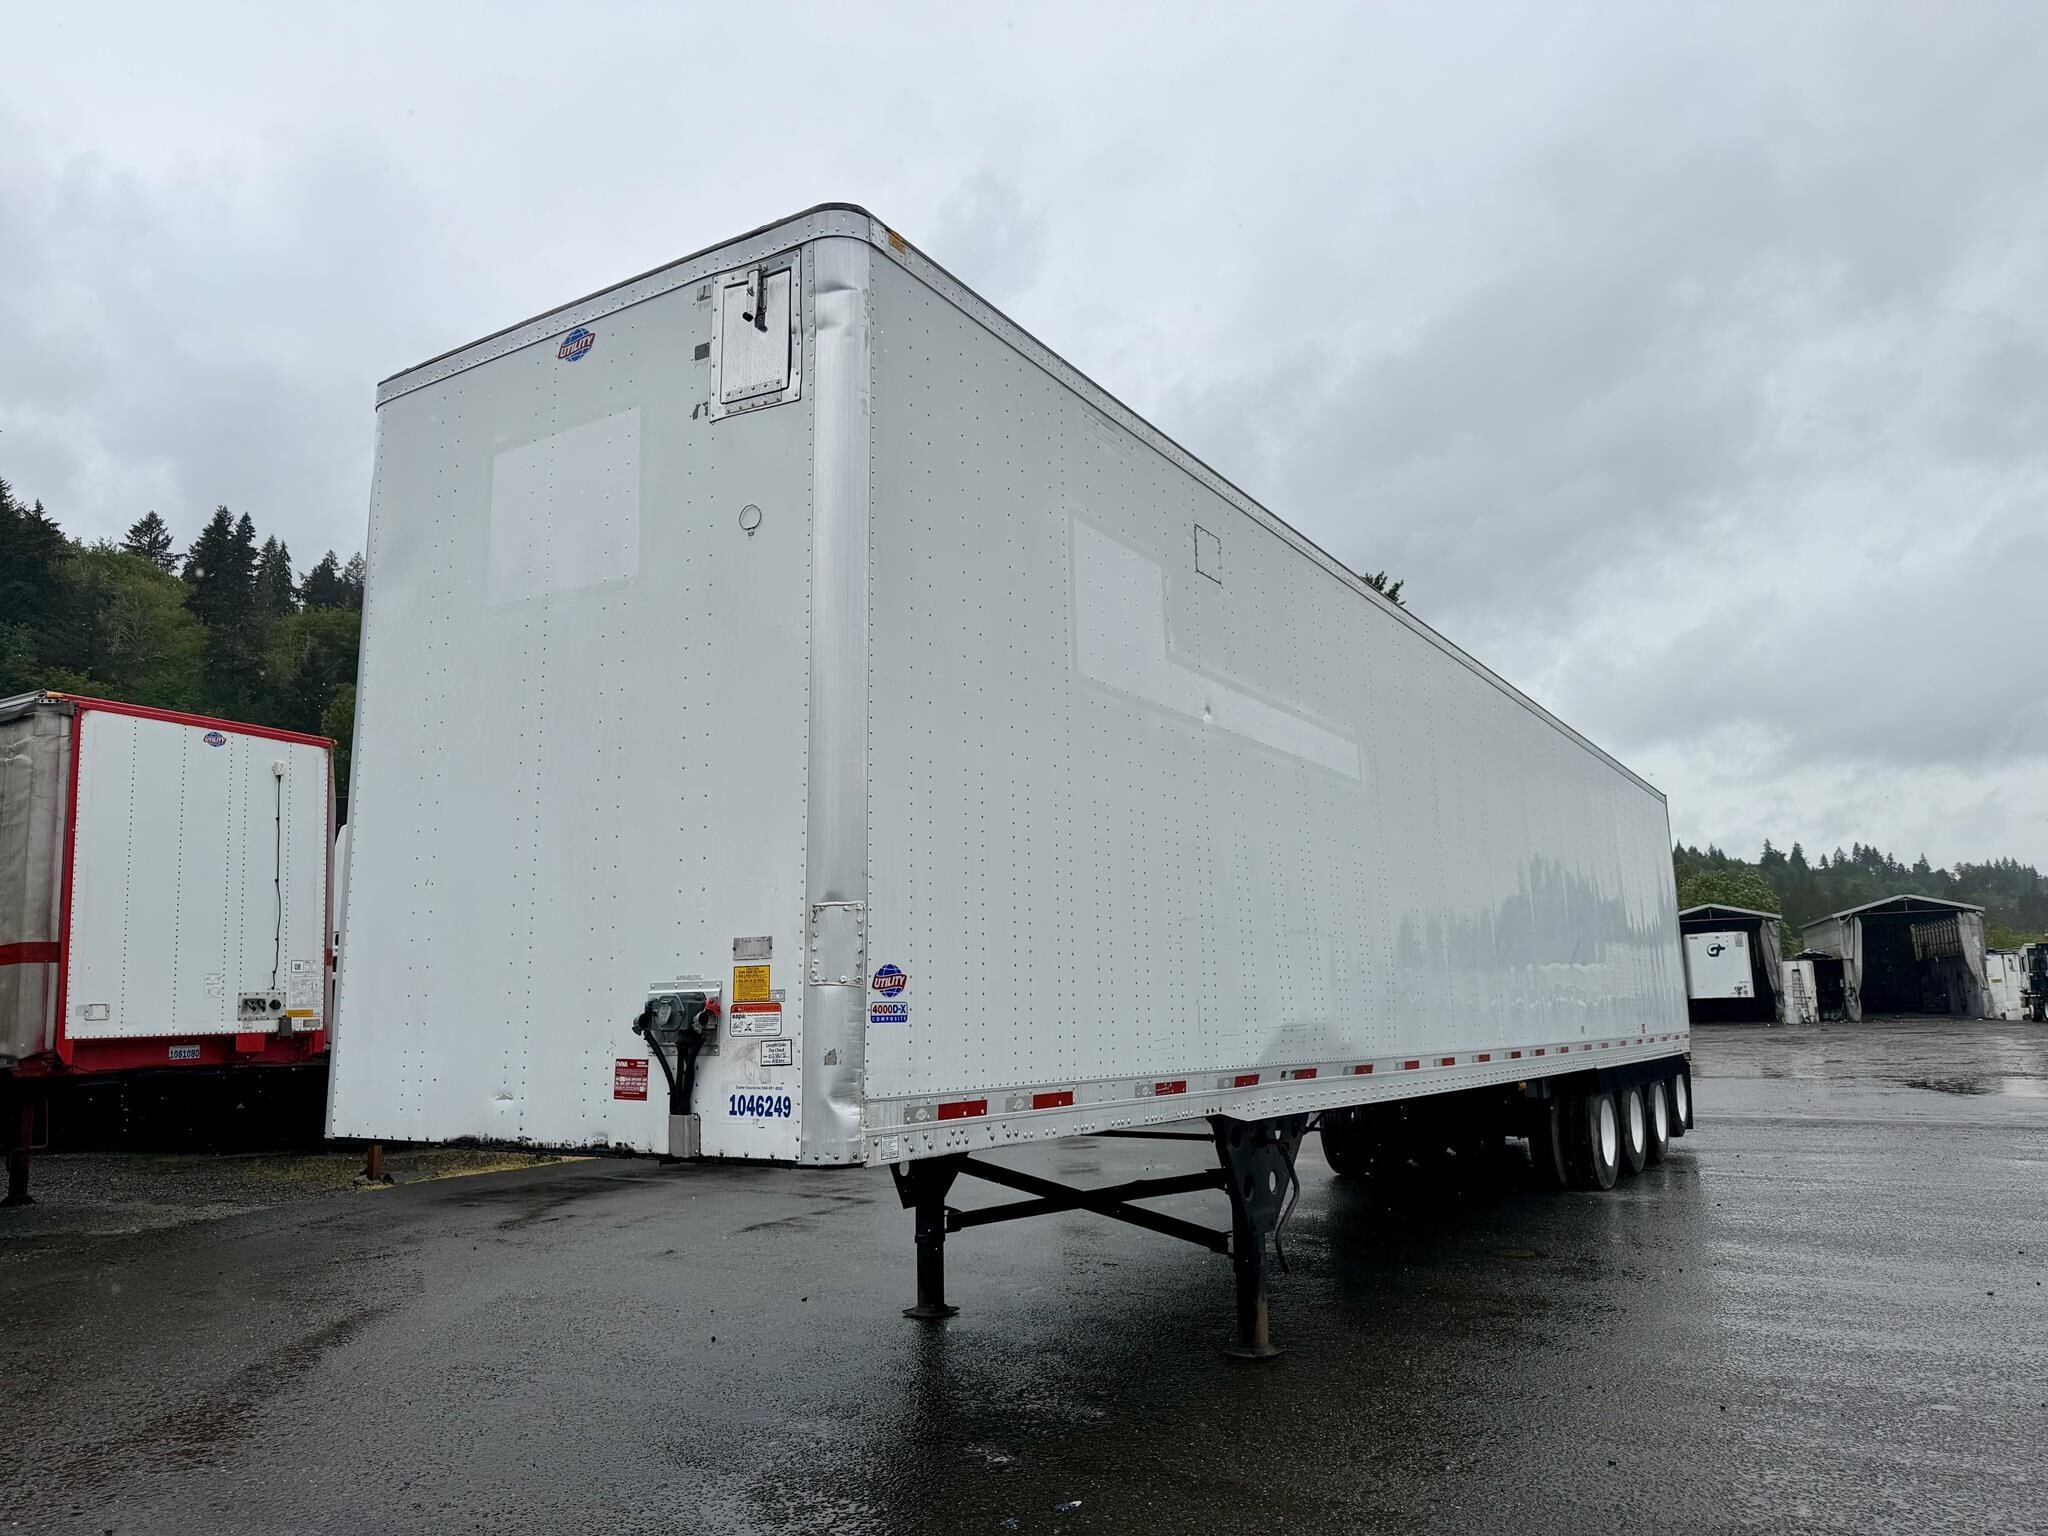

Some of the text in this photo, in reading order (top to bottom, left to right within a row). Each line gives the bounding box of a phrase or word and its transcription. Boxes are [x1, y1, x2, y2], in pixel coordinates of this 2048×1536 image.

[560, 333, 594, 358] UTILITY
[204, 735, 225, 743] UTILITY
[873, 975, 906, 988] UTILITY
[872, 1004, 906, 1014] 4000D-X
[170, 1048, 200, 1059] 1081080
[728, 1094, 792, 1118] 1046249
